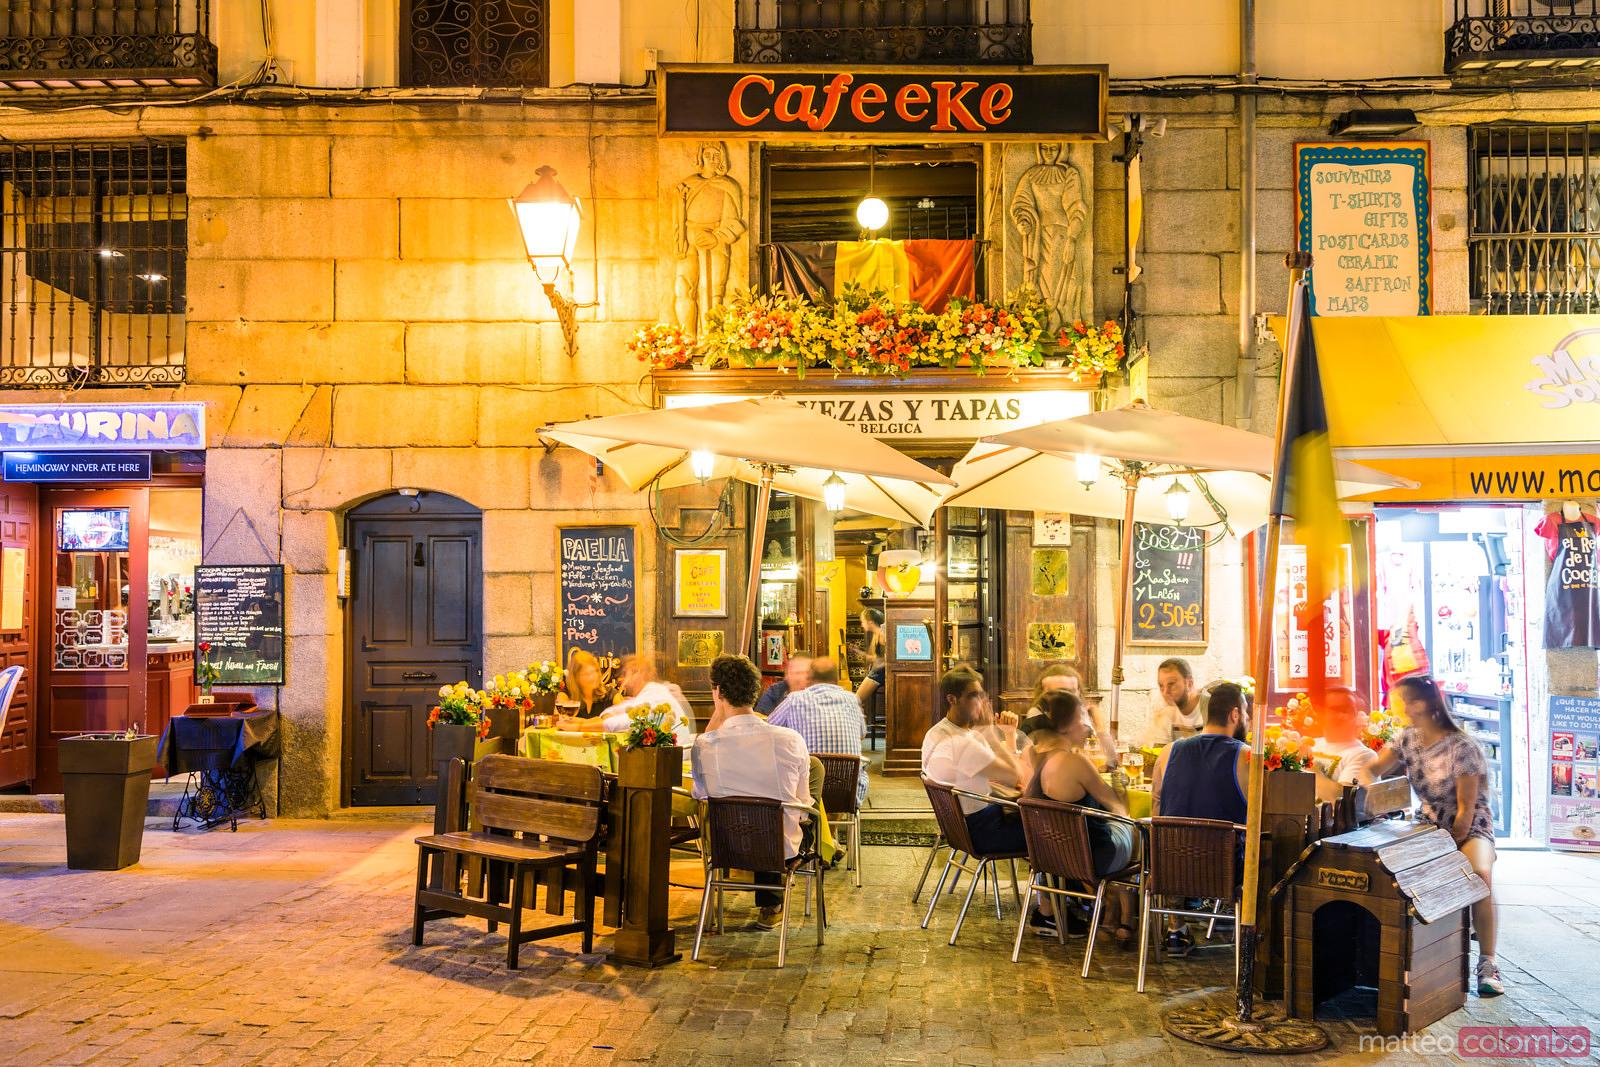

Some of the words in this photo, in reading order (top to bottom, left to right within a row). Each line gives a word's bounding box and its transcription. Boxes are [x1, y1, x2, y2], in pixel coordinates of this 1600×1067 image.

[1316, 168, 1392, 185] SOUVENIRS
[1329, 191, 1402, 210] T-SHIRTS
[1363, 211, 1409, 228] GIFTS
[1318, 233, 1410, 251] POSTCARDS
[1337, 254, 1399, 271] CERAMIC
[1344, 276, 1412, 293] SAFFRON
[1327, 296, 1369, 313] MAPS
[904, 399, 924, 421] Y
[931, 399, 1021, 421] TAPAS
[8, 411, 200, 442] TAURINA
[860, 423, 922, 434] BELGICA
[15, 463, 69, 473] HEMINGWAY
[71, 463, 99, 473] NEVER
[100, 463, 116, 473] ATE
[118, 463, 140, 473] HERE
[562, 537, 630, 562] PAELLA
[1581, 537, 1597, 553] Re
[1565, 551, 1582, 567] de
[567, 603, 606, 616] Prueba
[566, 617, 584, 630] Try
